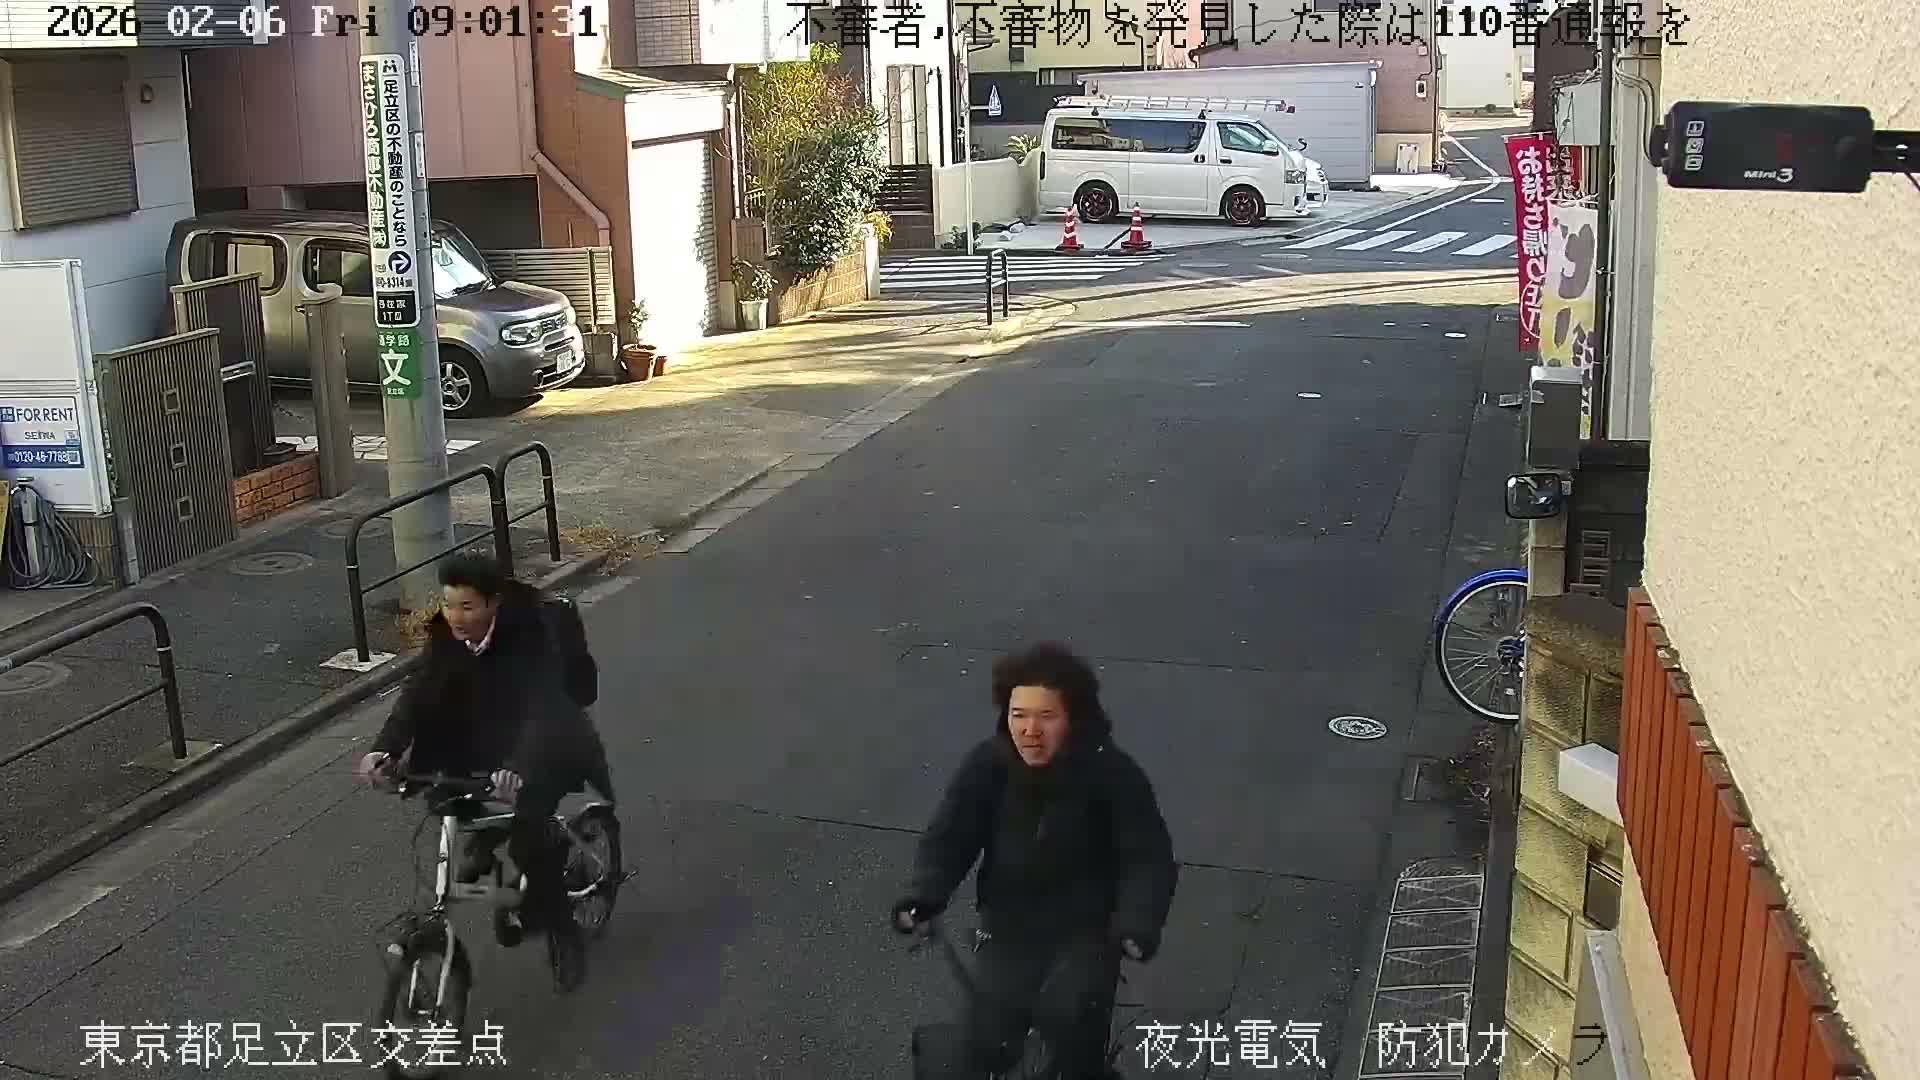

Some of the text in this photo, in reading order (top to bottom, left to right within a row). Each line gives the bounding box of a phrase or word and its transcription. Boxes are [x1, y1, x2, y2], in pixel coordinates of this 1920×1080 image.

[383, 79, 408, 248] 足立区の不動産のことなら
[380, 348, 412, 386] 文
[16, 407, 41, 422] FOR
[42, 407, 74, 422] RENT
